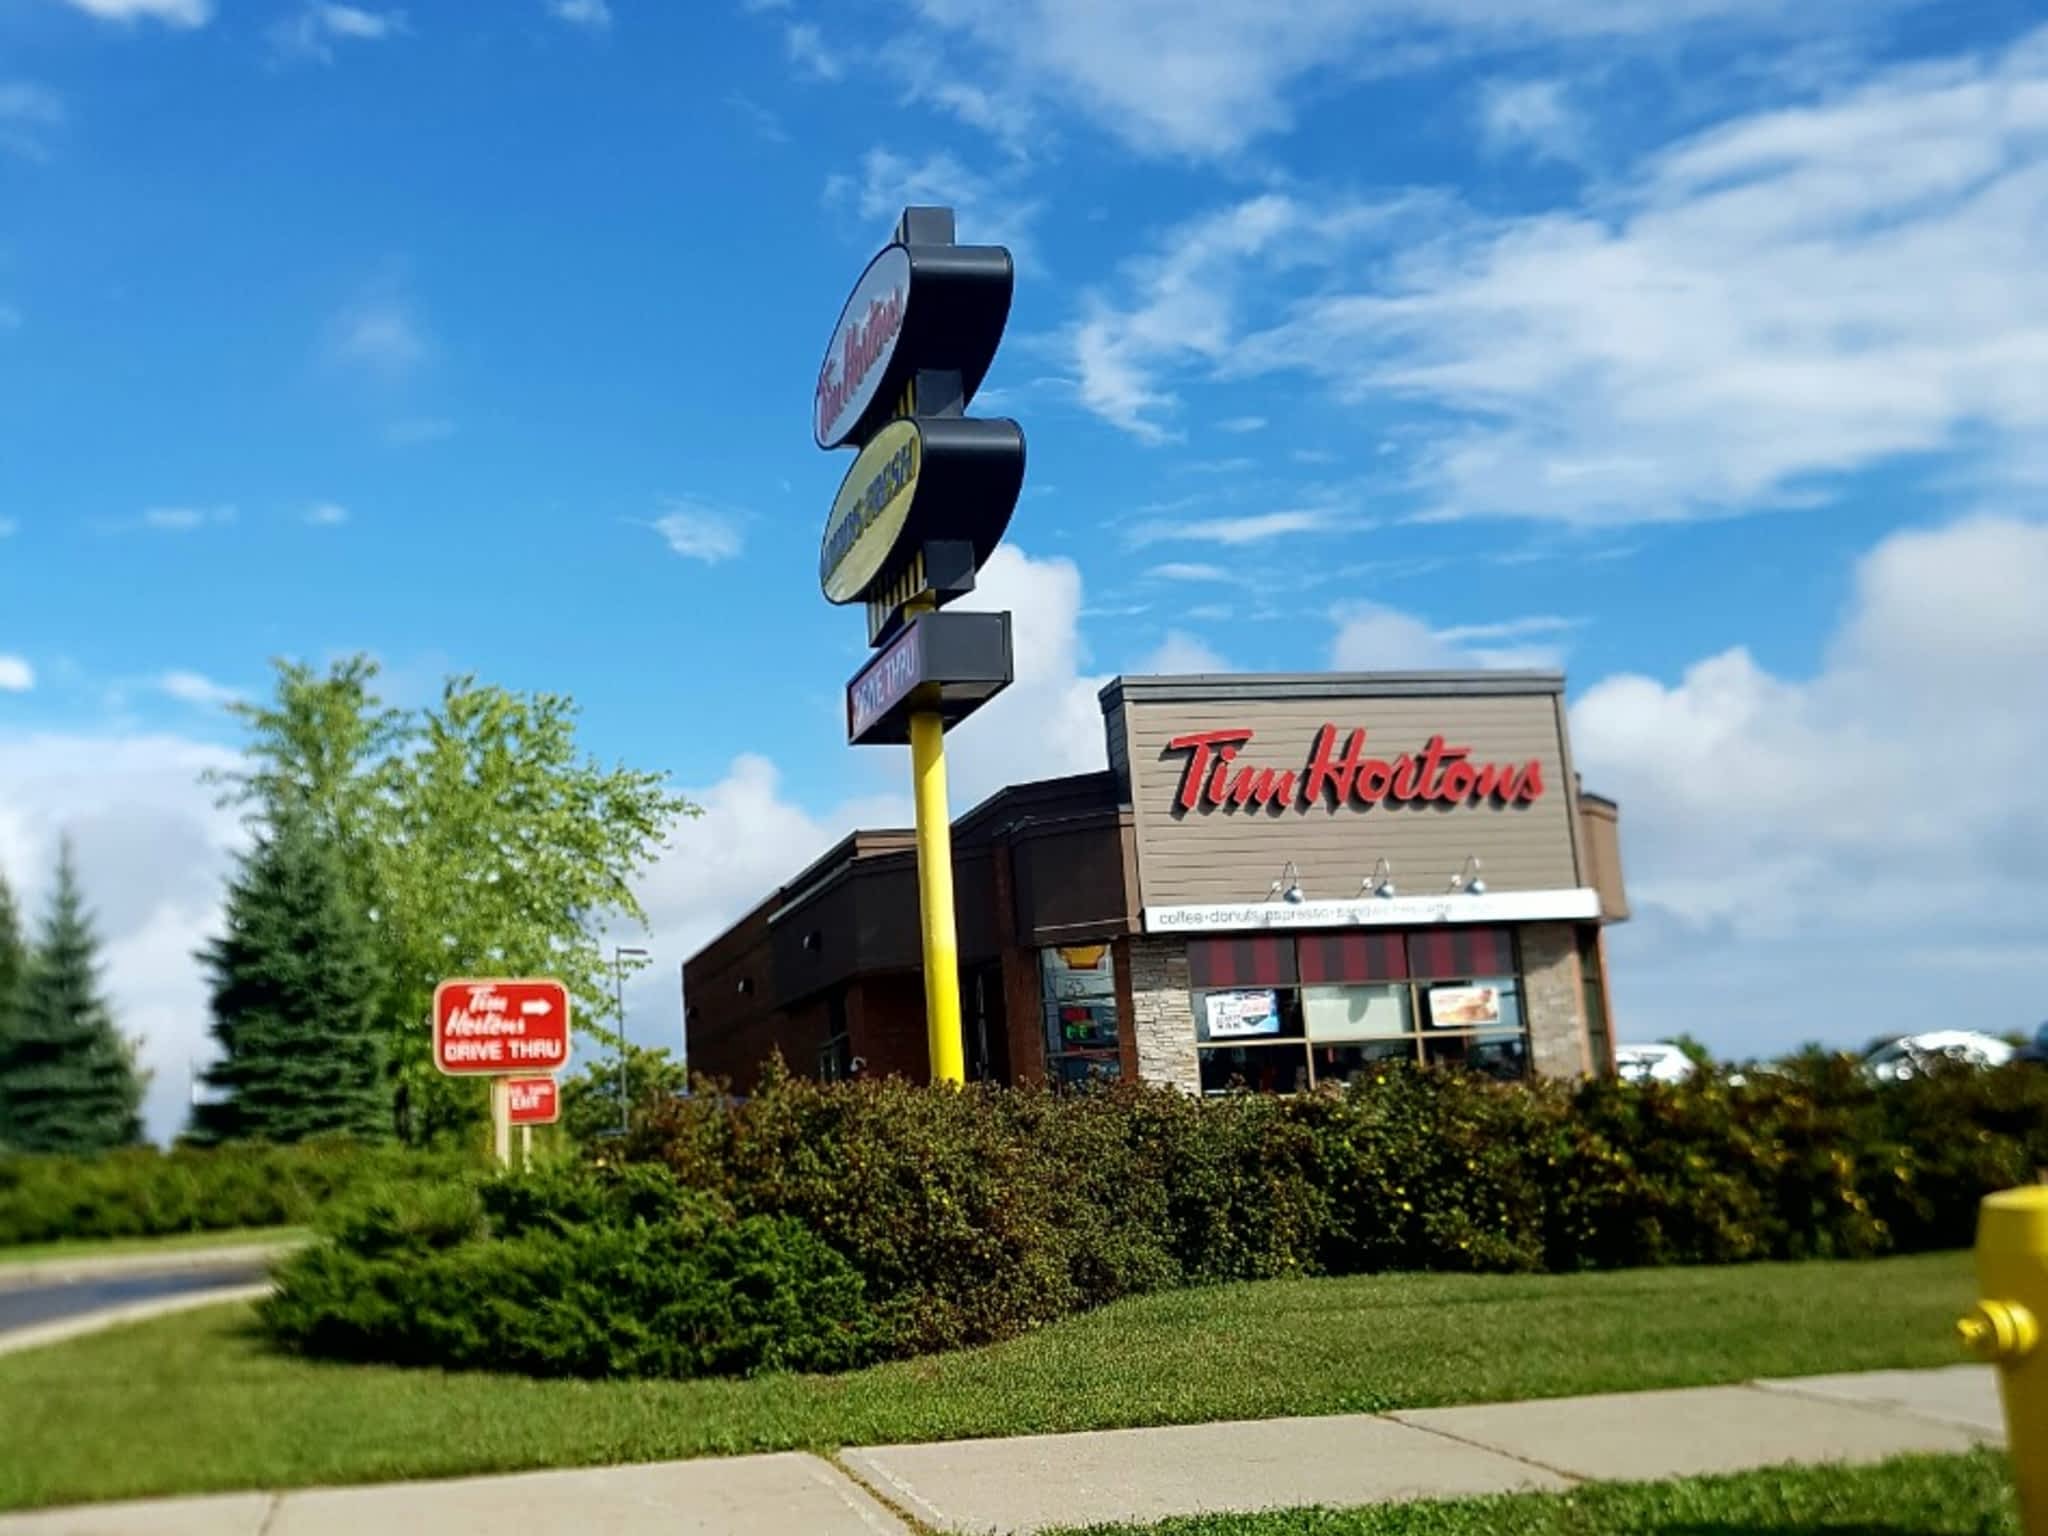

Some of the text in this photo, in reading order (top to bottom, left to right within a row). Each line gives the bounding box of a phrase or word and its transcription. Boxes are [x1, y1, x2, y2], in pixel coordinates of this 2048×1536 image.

[885, 638, 914, 696] THRU
[1170, 722, 1544, 809] Tim Hortons
[1159, 910, 1203, 925] coffee
[467, 985, 508, 1013] Tim
[445, 1007, 525, 1036] Hortons
[445, 1038, 561, 1061] DRIVE THRU
